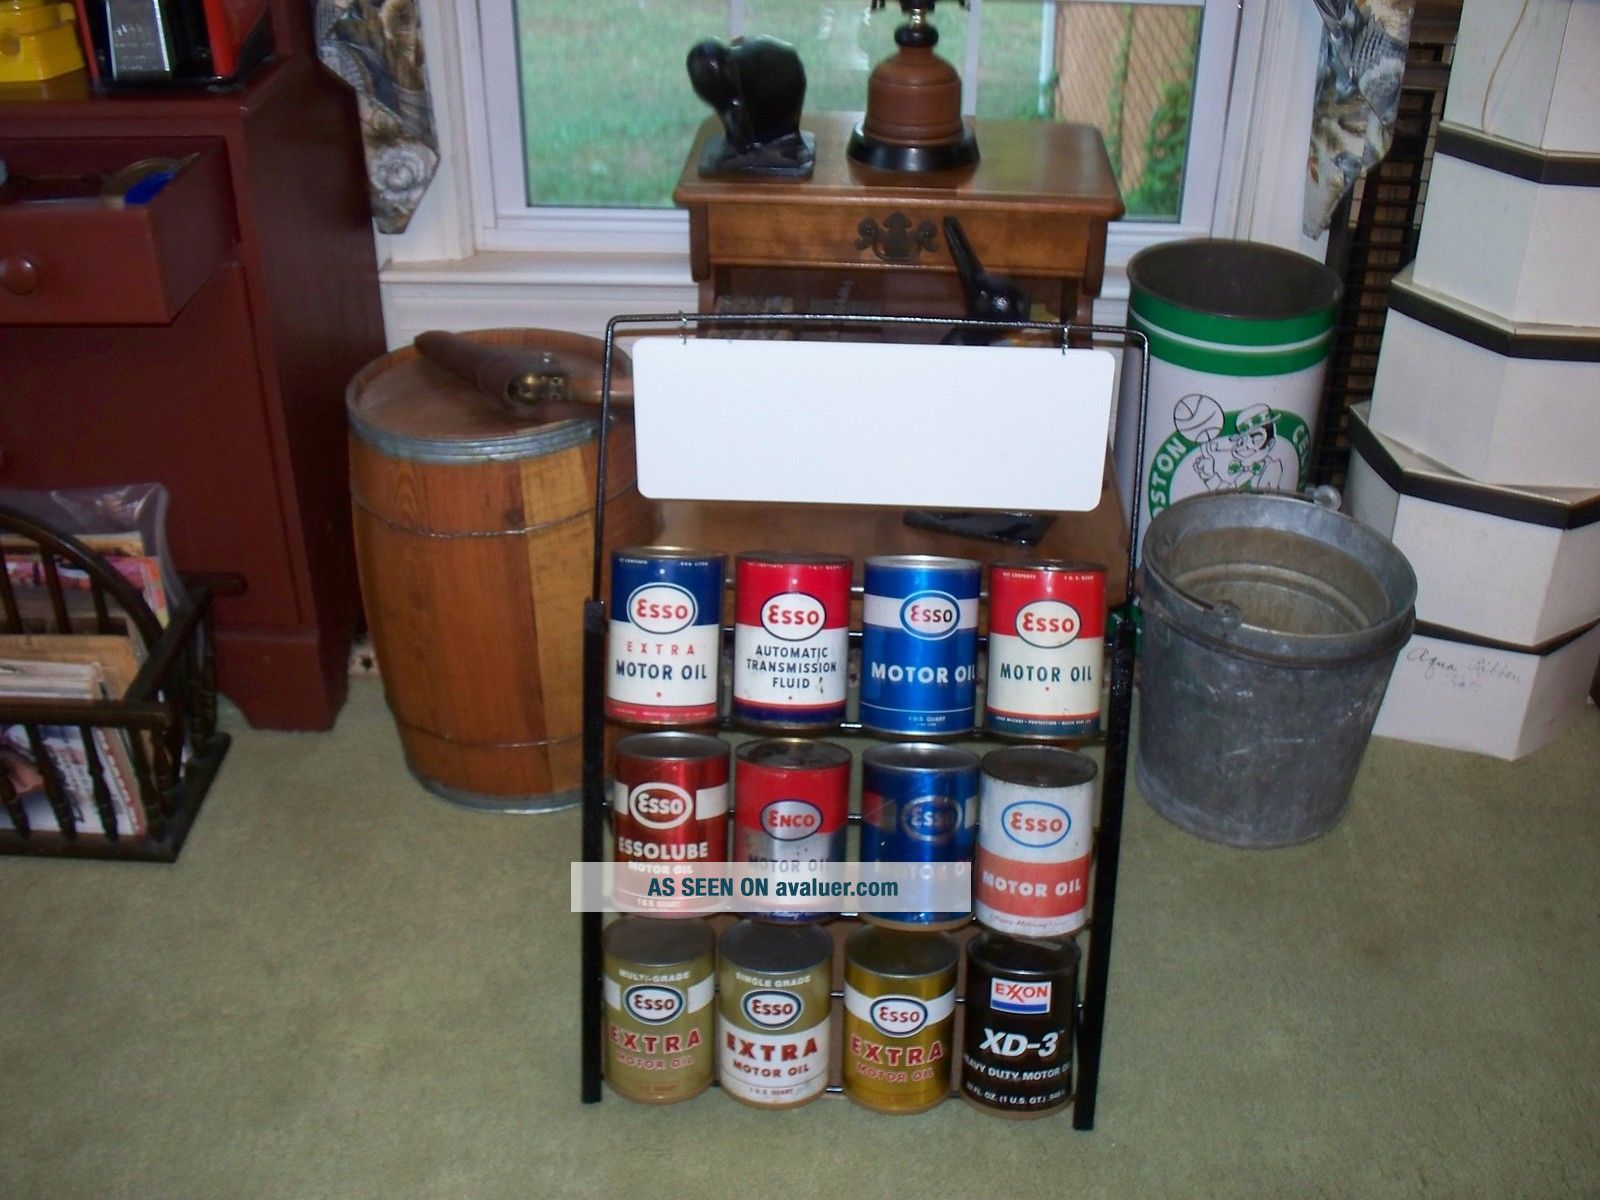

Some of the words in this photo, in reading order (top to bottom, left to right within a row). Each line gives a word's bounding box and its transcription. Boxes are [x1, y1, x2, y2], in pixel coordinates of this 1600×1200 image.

[625, 641, 696, 656] EXTRA
[755, 645, 829, 659] AUTOMATIC
[615, 659, 673, 681] MOTOR
[681, 664, 708, 681] OIL
[746, 658, 837, 674] TRANSMISSION
[871, 661, 949, 685] MOTOR
[1000, 662, 1061, 682] MOTOR
[1070, 666, 1093, 682] OIL
[772, 677, 811, 689] FLUID
[618, 836, 709, 860] ESSOLUBE
[628, 860, 671, 875] MOTOR
[982, 870, 1048, 897] MOTOR
[1055, 877, 1082, 897] OIL
[774, 975, 812, 988] GRADE
[995, 982, 1048, 1003] EXXON
[609, 1022, 704, 1054] EXTRA
[726, 1031, 818, 1062] EXTRA
[979, 1028, 1059, 1058] XD-3
[850, 1033, 944, 1067] EXTRA
[732, 1059, 781, 1078] MOTOR
[787, 1063, 810, 1077] OIL
[987, 1067, 1018, 1080] DUTY
[1022, 1066, 1061, 1081] MOTOR
